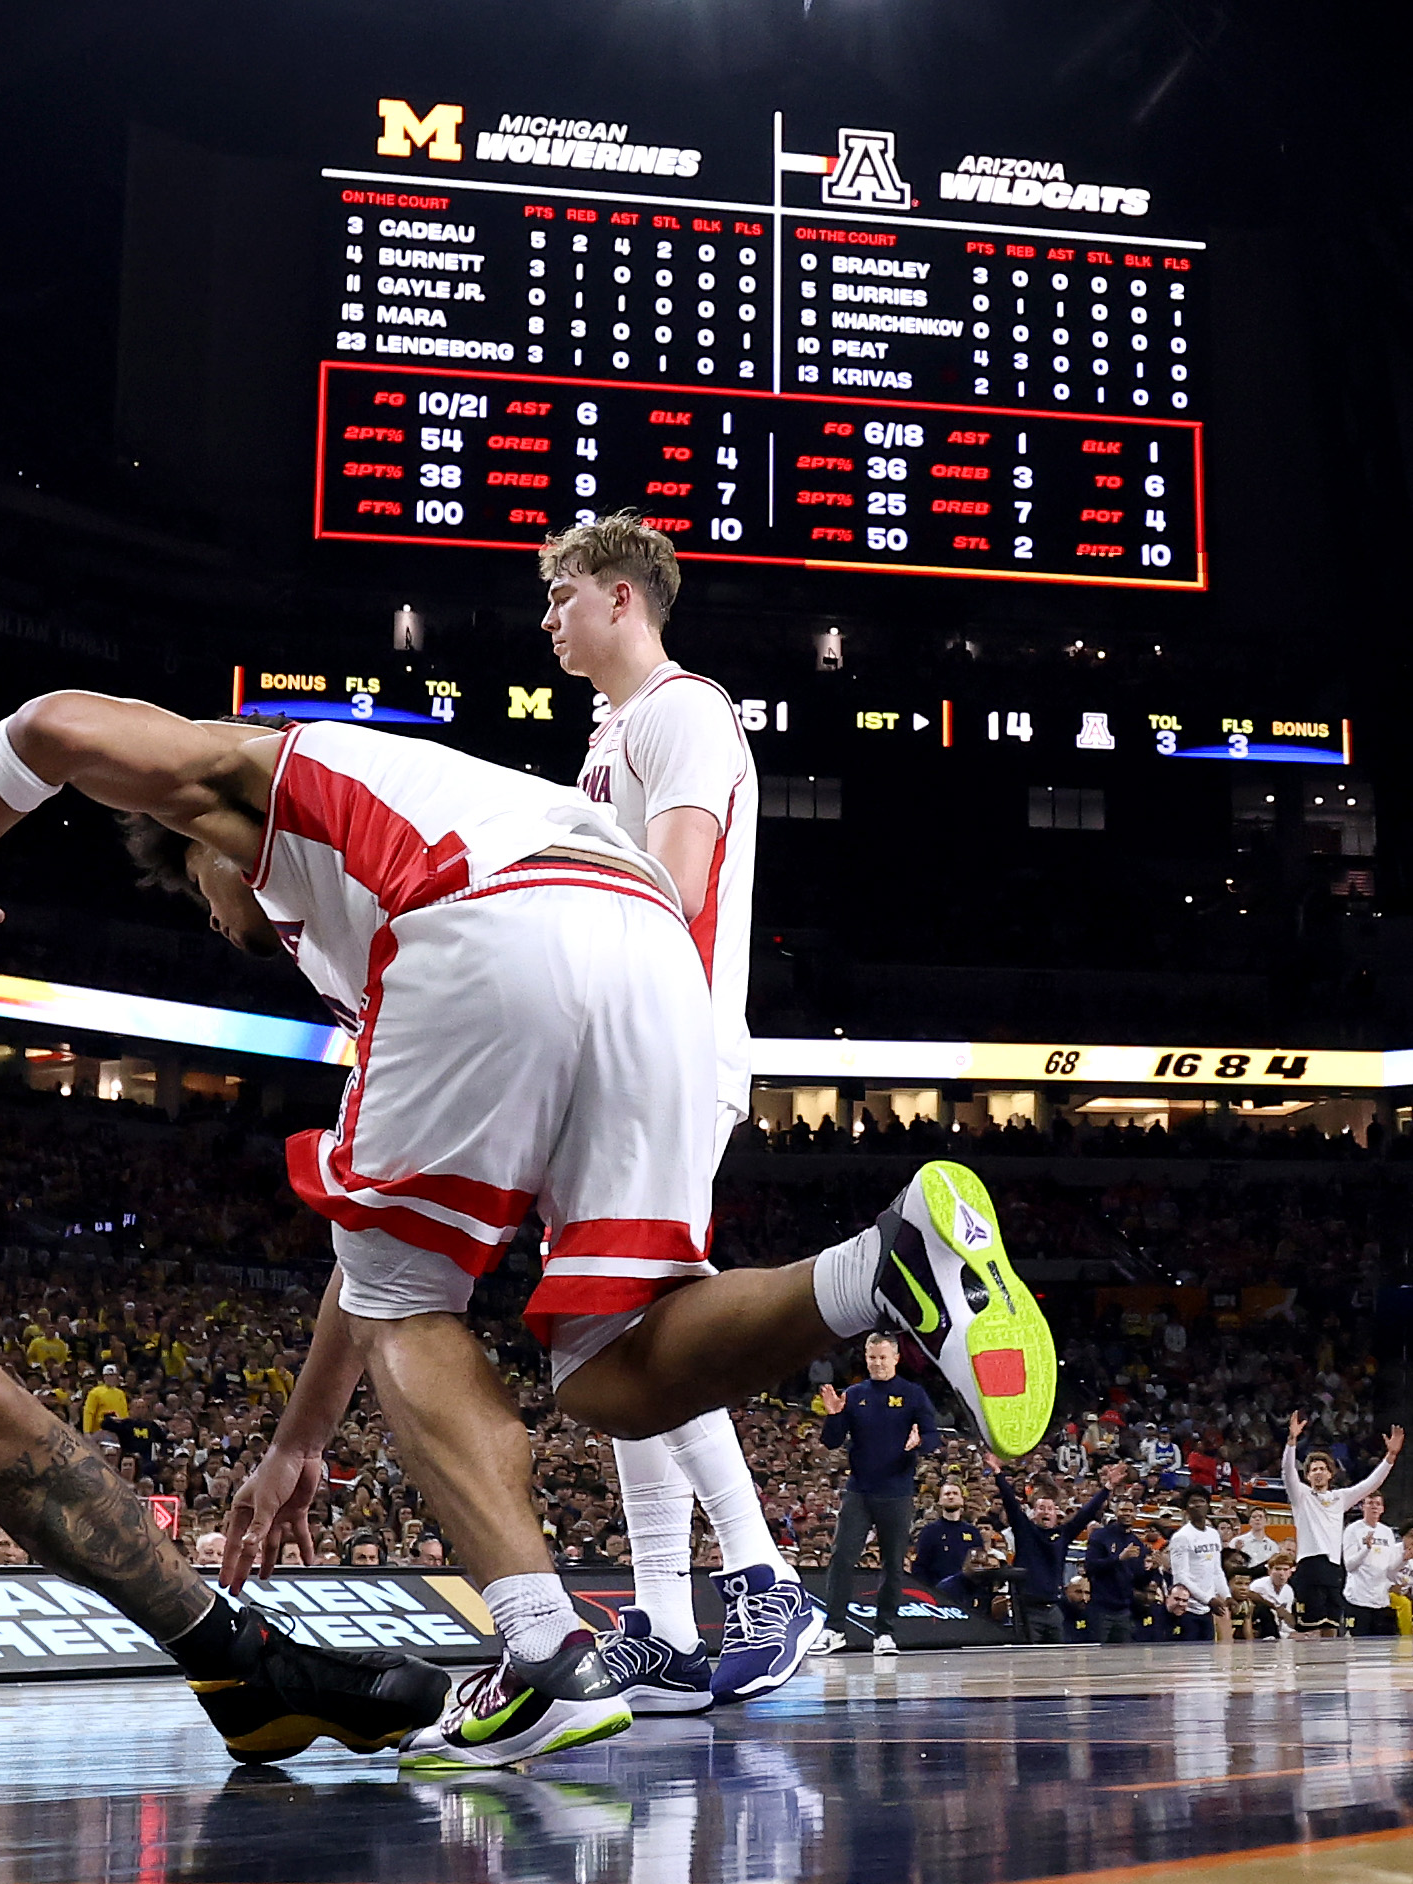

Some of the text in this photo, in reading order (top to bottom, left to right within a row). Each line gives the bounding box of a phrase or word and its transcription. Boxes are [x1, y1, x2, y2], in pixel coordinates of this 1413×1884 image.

[498, 113, 628, 142] MICHIGAN
[475, 131, 703, 178] WOLVERINES
[957, 156, 1064, 181] ARIZONA
[940, 172, 1150, 216] WILDCATS
[342, 190, 763, 235] ON THE COURT PTS REB AST STL BLK FLS
[348, 216, 756, 265] 3 CADEAU 5 2 4 2 0
[796, 228, 1190, 271] ON THE COURT PTS REB AST STL BLK FLS
[347, 245, 672, 286] 4 BURNETT 3 0
[801, 254, 1184, 299] 0 BRADLEY 3 0 2
[378, 277, 450, 298] GAYLE
[454, 283, 485, 301] JR.
[698, 301, 714, 318] 0
[802, 281, 927, 307] 5 BURRIES
[342, 303, 630, 340] 15 MARA 8 3 0
[801, 309, 1147, 351] 8 KHARCHENKOV 0
[337, 332, 754, 377] 23 LENDEBORG 3 2
[798, 337, 1069, 372] 10 PEAT 4 3 0
[799, 365, 988, 394] 13 KRIVAS 2
[374, 392, 692, 425] FG 10/21 AST 6 BLK
[344, 426, 738, 469] 2PT% 54 OREB 4 TO 4
[824, 422, 1122, 453] FG 6/18 AST BLK
[343, 462, 736, 504] 3PT% 38 DREB 9 POT 7
[796, 456, 1164, 497] 2PT% 36 OREB 3 TO 6
[358, 500, 402, 515] FT%
[417, 500, 463, 525] 100
[509, 509, 548, 524] STL
[712, 518, 742, 541] 10
[797, 490, 1166, 531] 3PT% 25 DREB 7 POT 4
[812, 528, 853, 541] FT%
[868, 527, 907, 550] 50
[953, 536, 990, 550] STL
[1015, 536, 1032, 558] 2
[1142, 544, 1171, 566] 10
[260, 672, 327, 692] BONUS
[345, 676, 381, 694] FLS
[425, 680, 462, 698] TOL
[351, 693, 374, 720] 3
[431, 697, 455, 722] 4
[856, 711, 900, 730] 1ST
[1148, 714, 1183, 731] TOL
[987, 711, 1034, 742] 14
[1222, 718, 1254, 734] FLS
[1272, 720, 1330, 738] BONUS
[1156, 731, 1177, 755] 3
[1229, 733, 1251, 759] 3
[1045, 1049, 1081, 1076] 68
